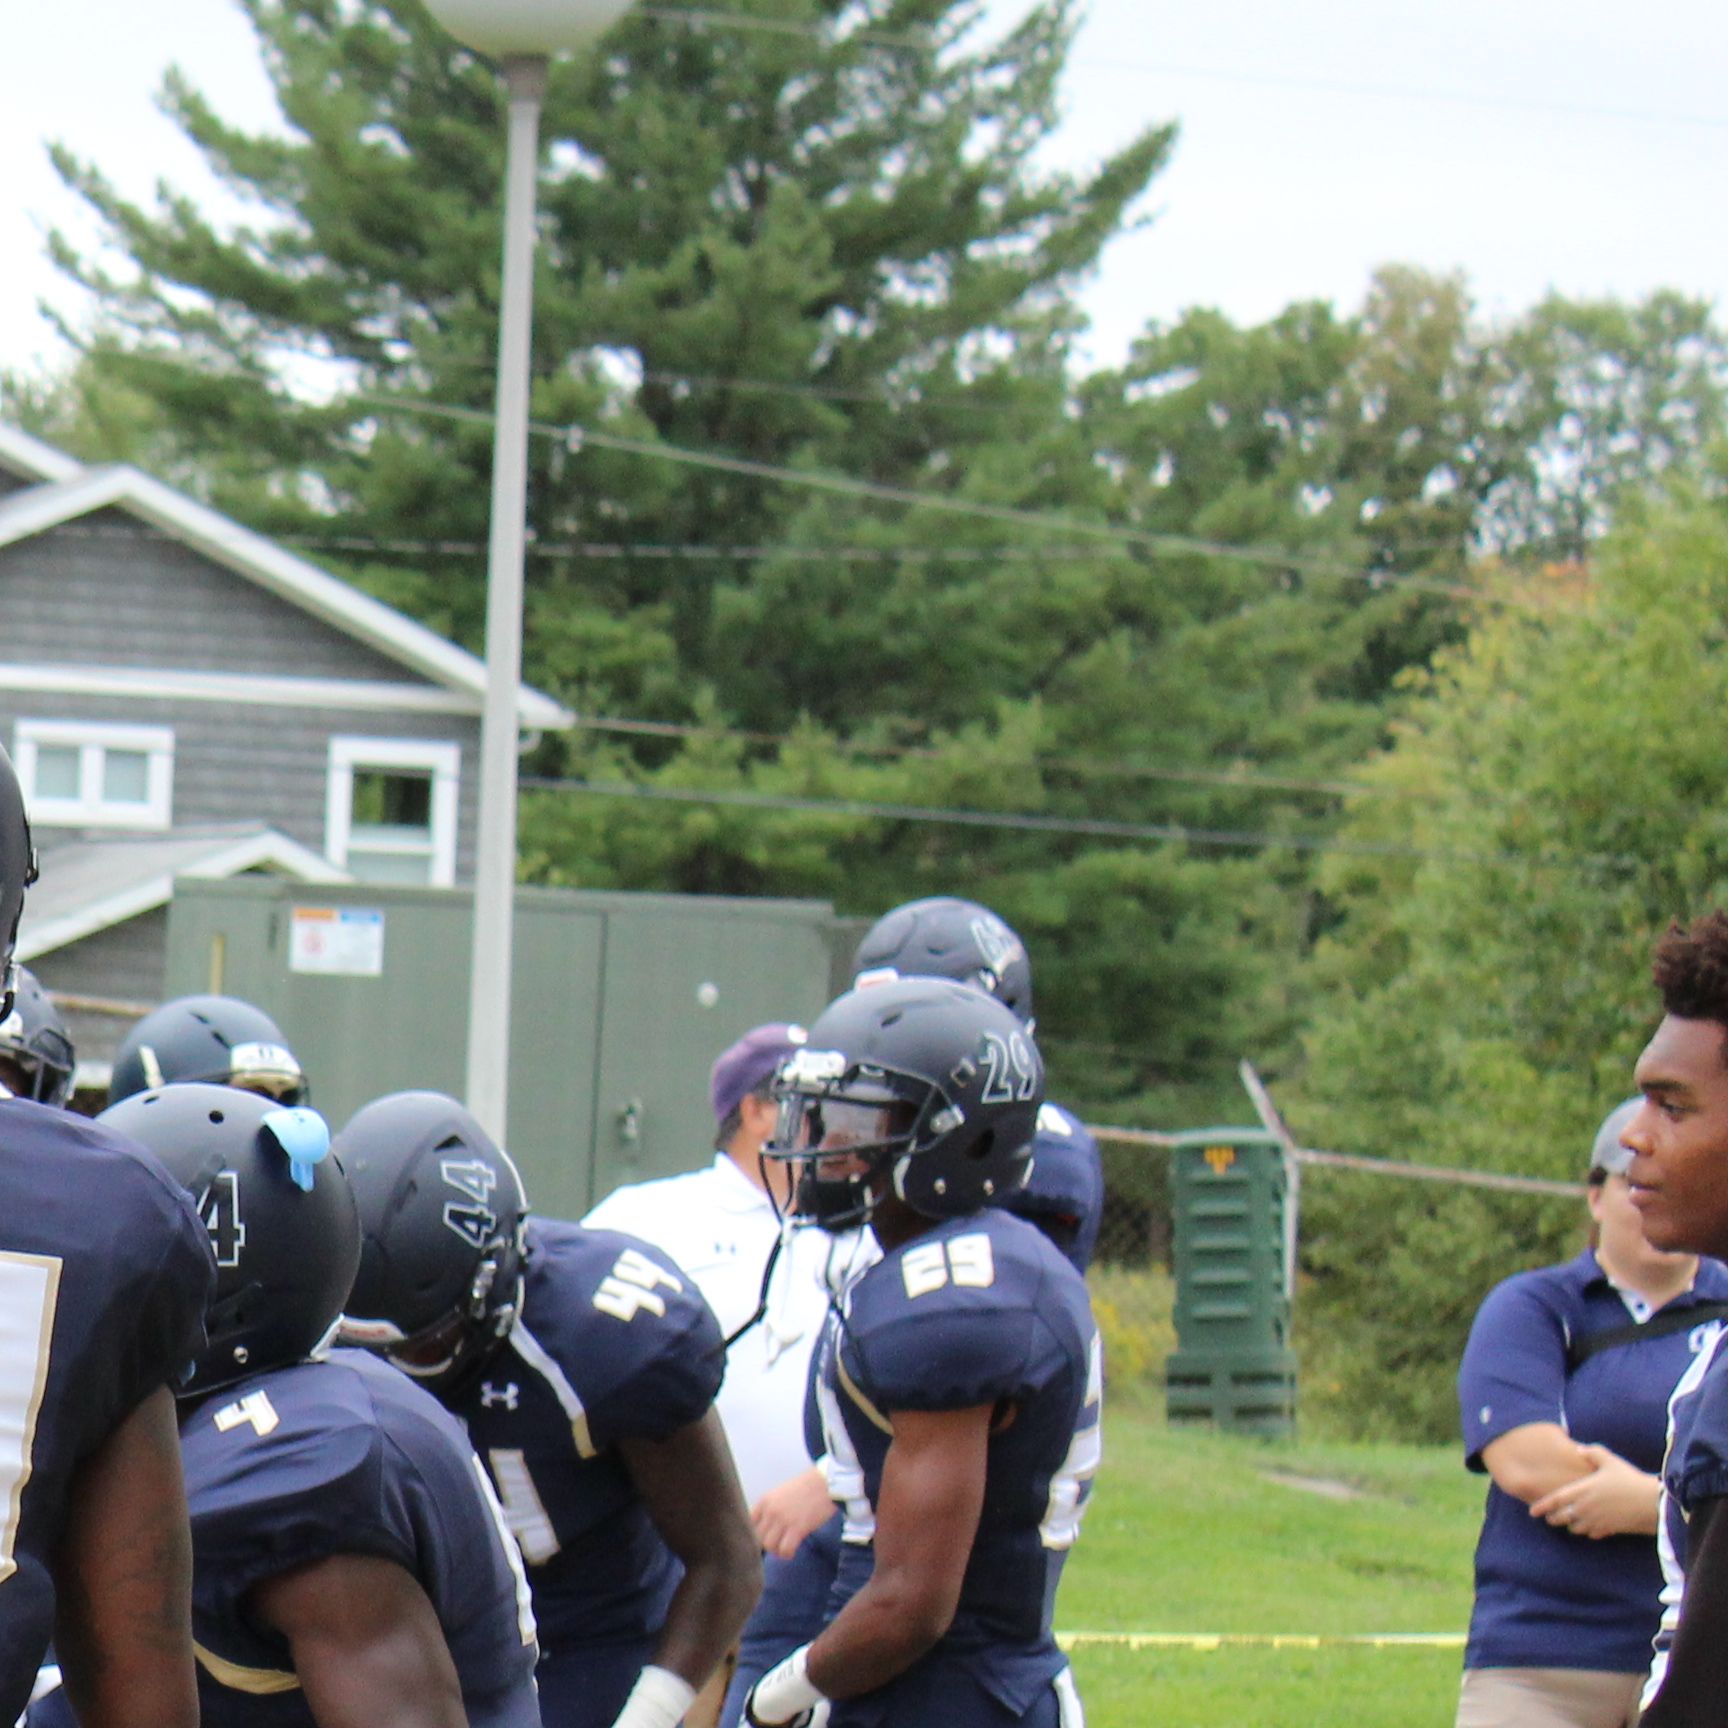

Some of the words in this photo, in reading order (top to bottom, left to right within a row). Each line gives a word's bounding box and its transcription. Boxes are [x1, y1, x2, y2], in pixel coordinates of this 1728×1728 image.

[979, 1030, 1037, 1105] 29
[440, 1159, 496, 1249] 44
[592, 1247, 683, 1322] 44
[213, 1389, 280, 1437] 4
